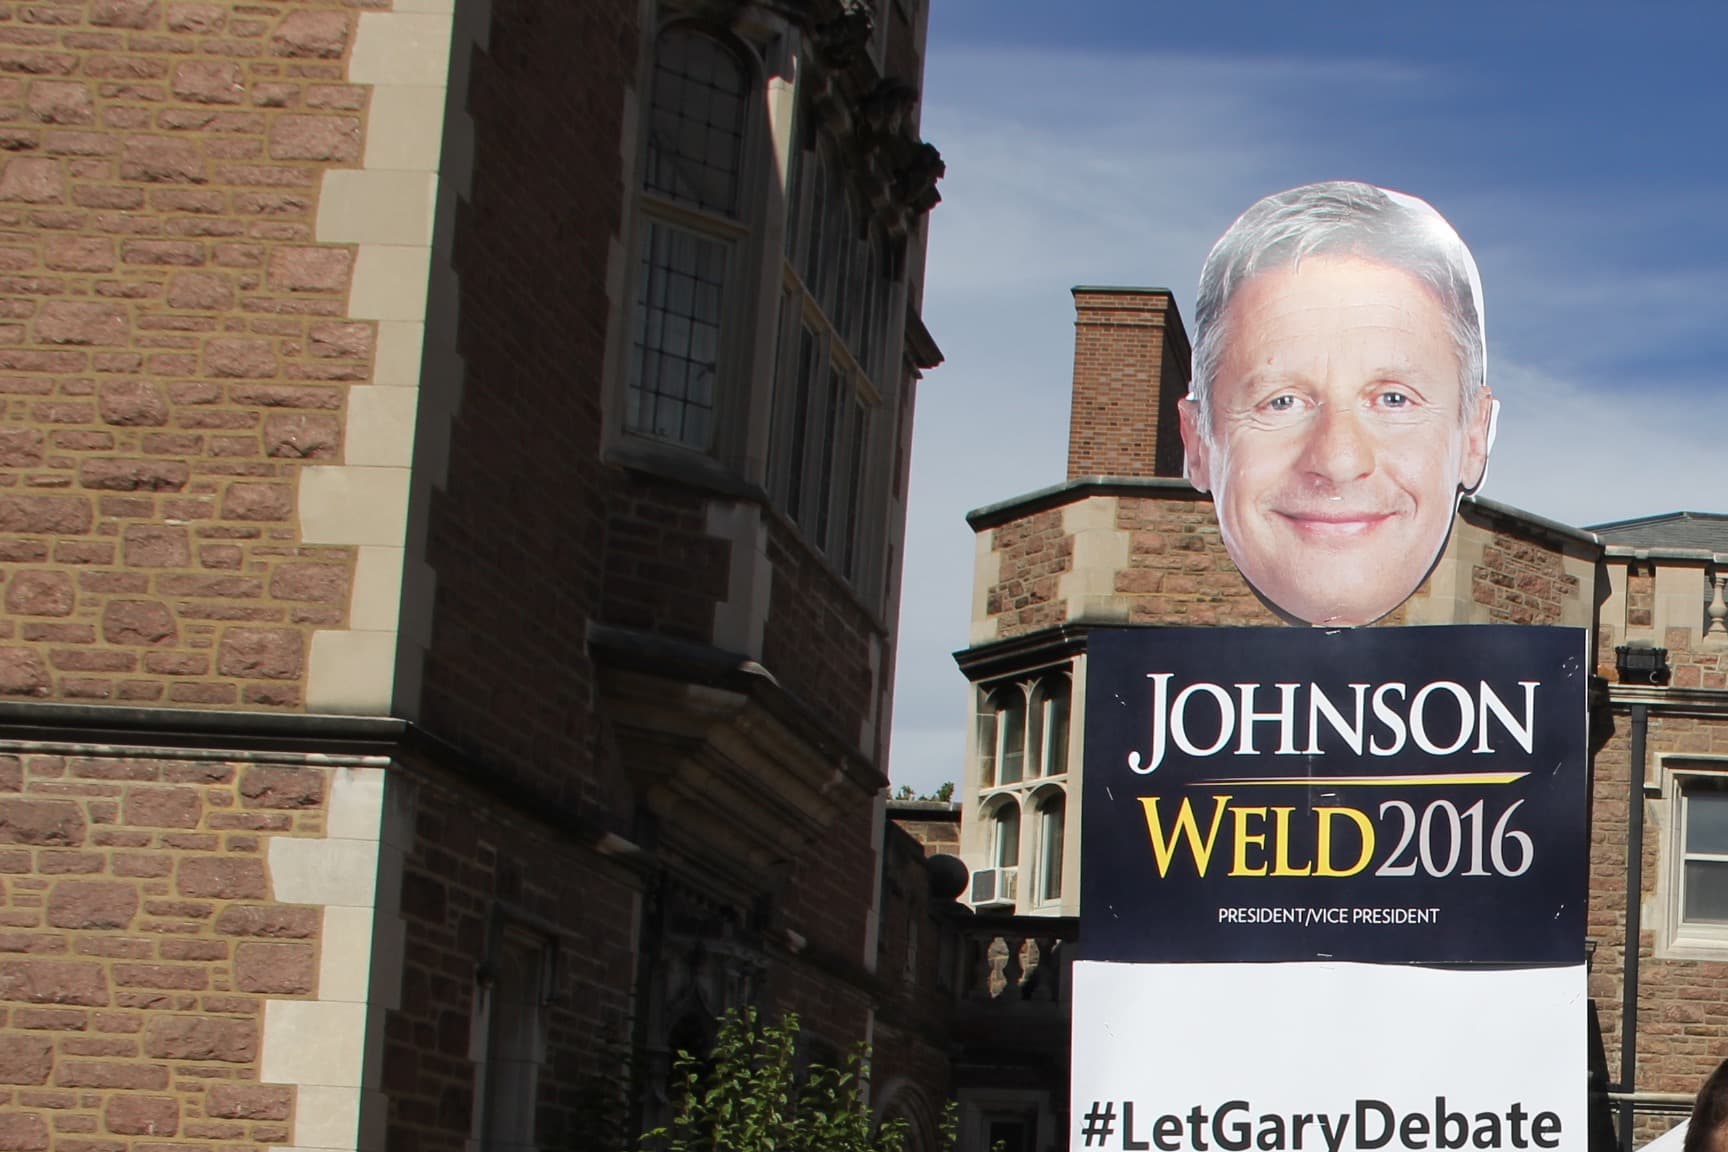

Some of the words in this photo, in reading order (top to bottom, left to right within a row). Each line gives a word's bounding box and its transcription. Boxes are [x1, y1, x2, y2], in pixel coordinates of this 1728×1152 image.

[1128, 673, 1540, 775] JOHNSON
[1218, 907, 1348, 927] PRESIDENT/VICE
[1352, 908, 1440, 925] PRESIDENT
